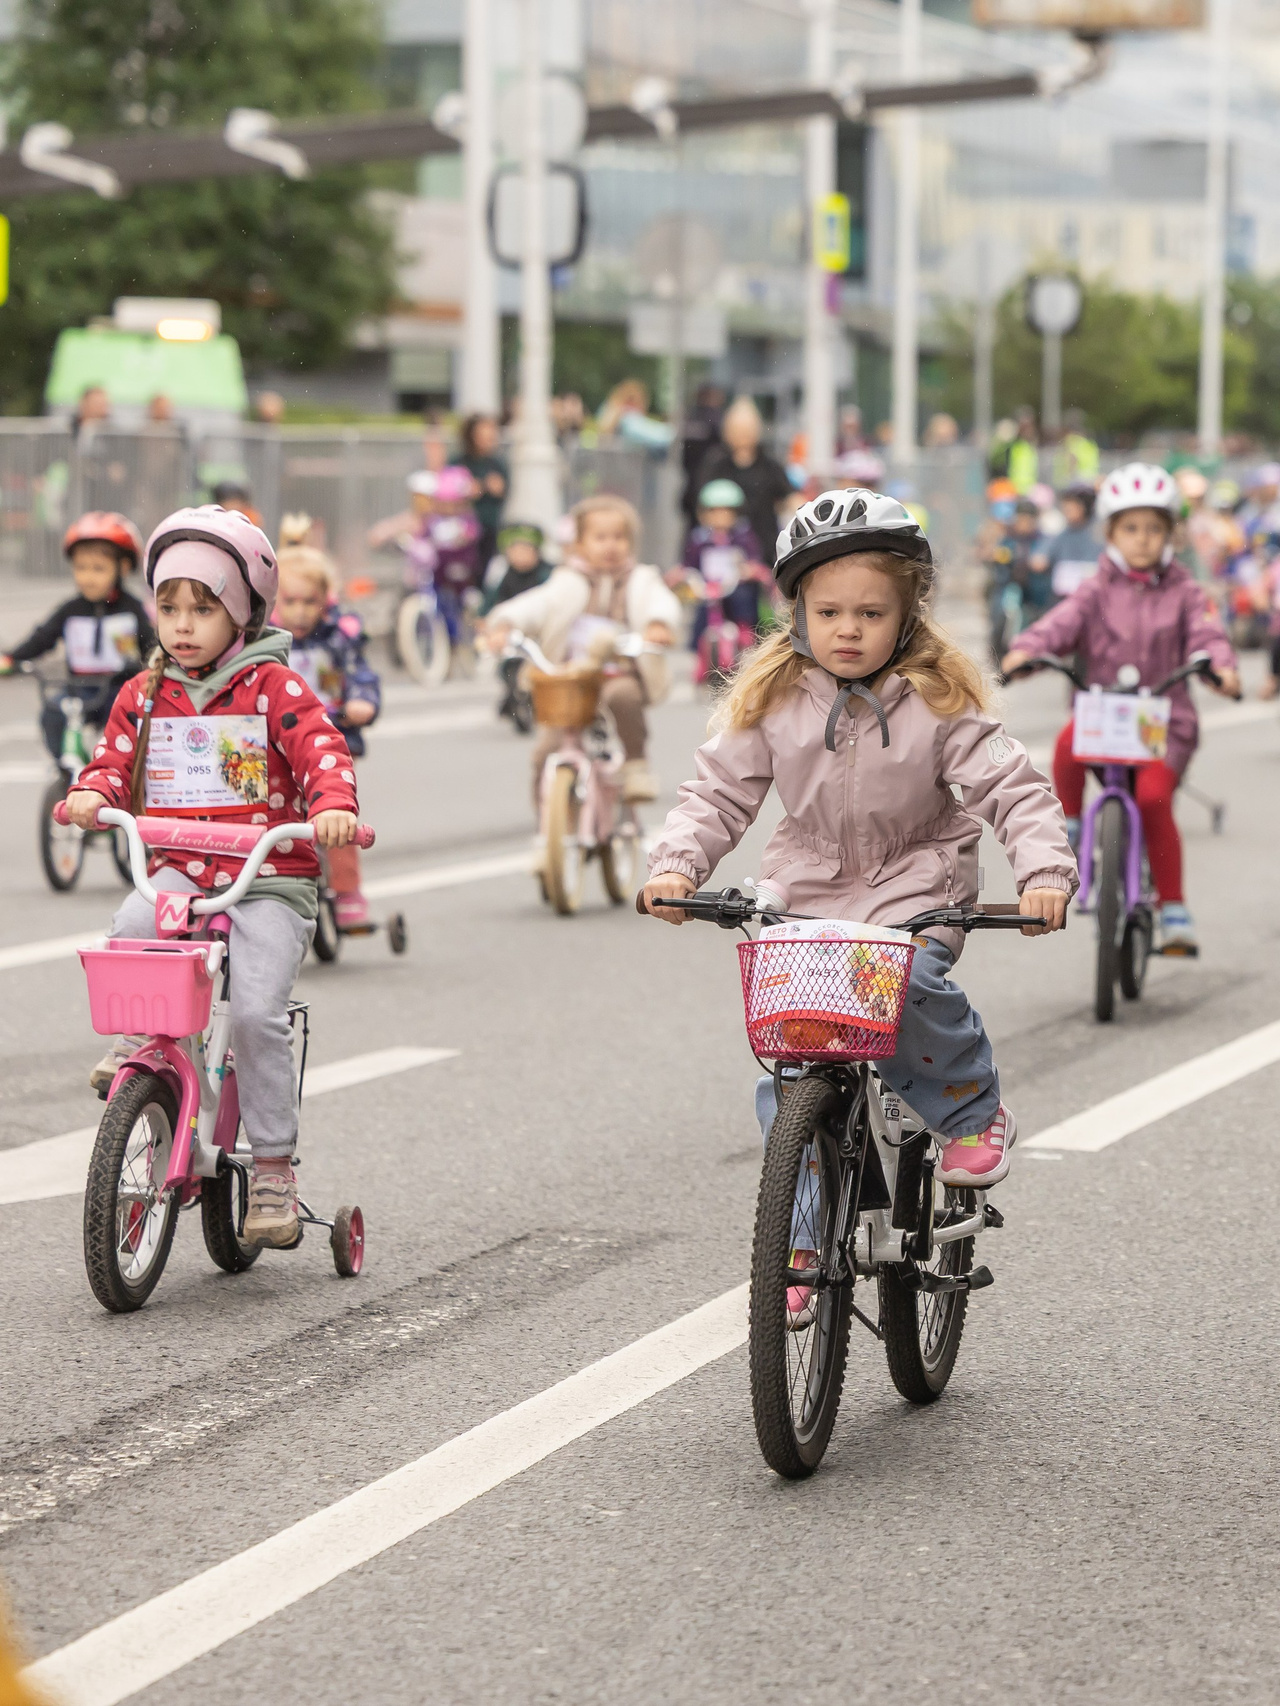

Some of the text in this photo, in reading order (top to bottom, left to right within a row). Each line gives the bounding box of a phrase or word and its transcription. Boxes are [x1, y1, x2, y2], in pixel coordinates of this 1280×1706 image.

[187, 766, 212, 775] 0955
[158, 827, 240, 850] Novatrack
[766, 927, 787, 936] ЛЕТО
[807, 968, 838, 980] 0457
[884, 1108, 900, 1118] TO
